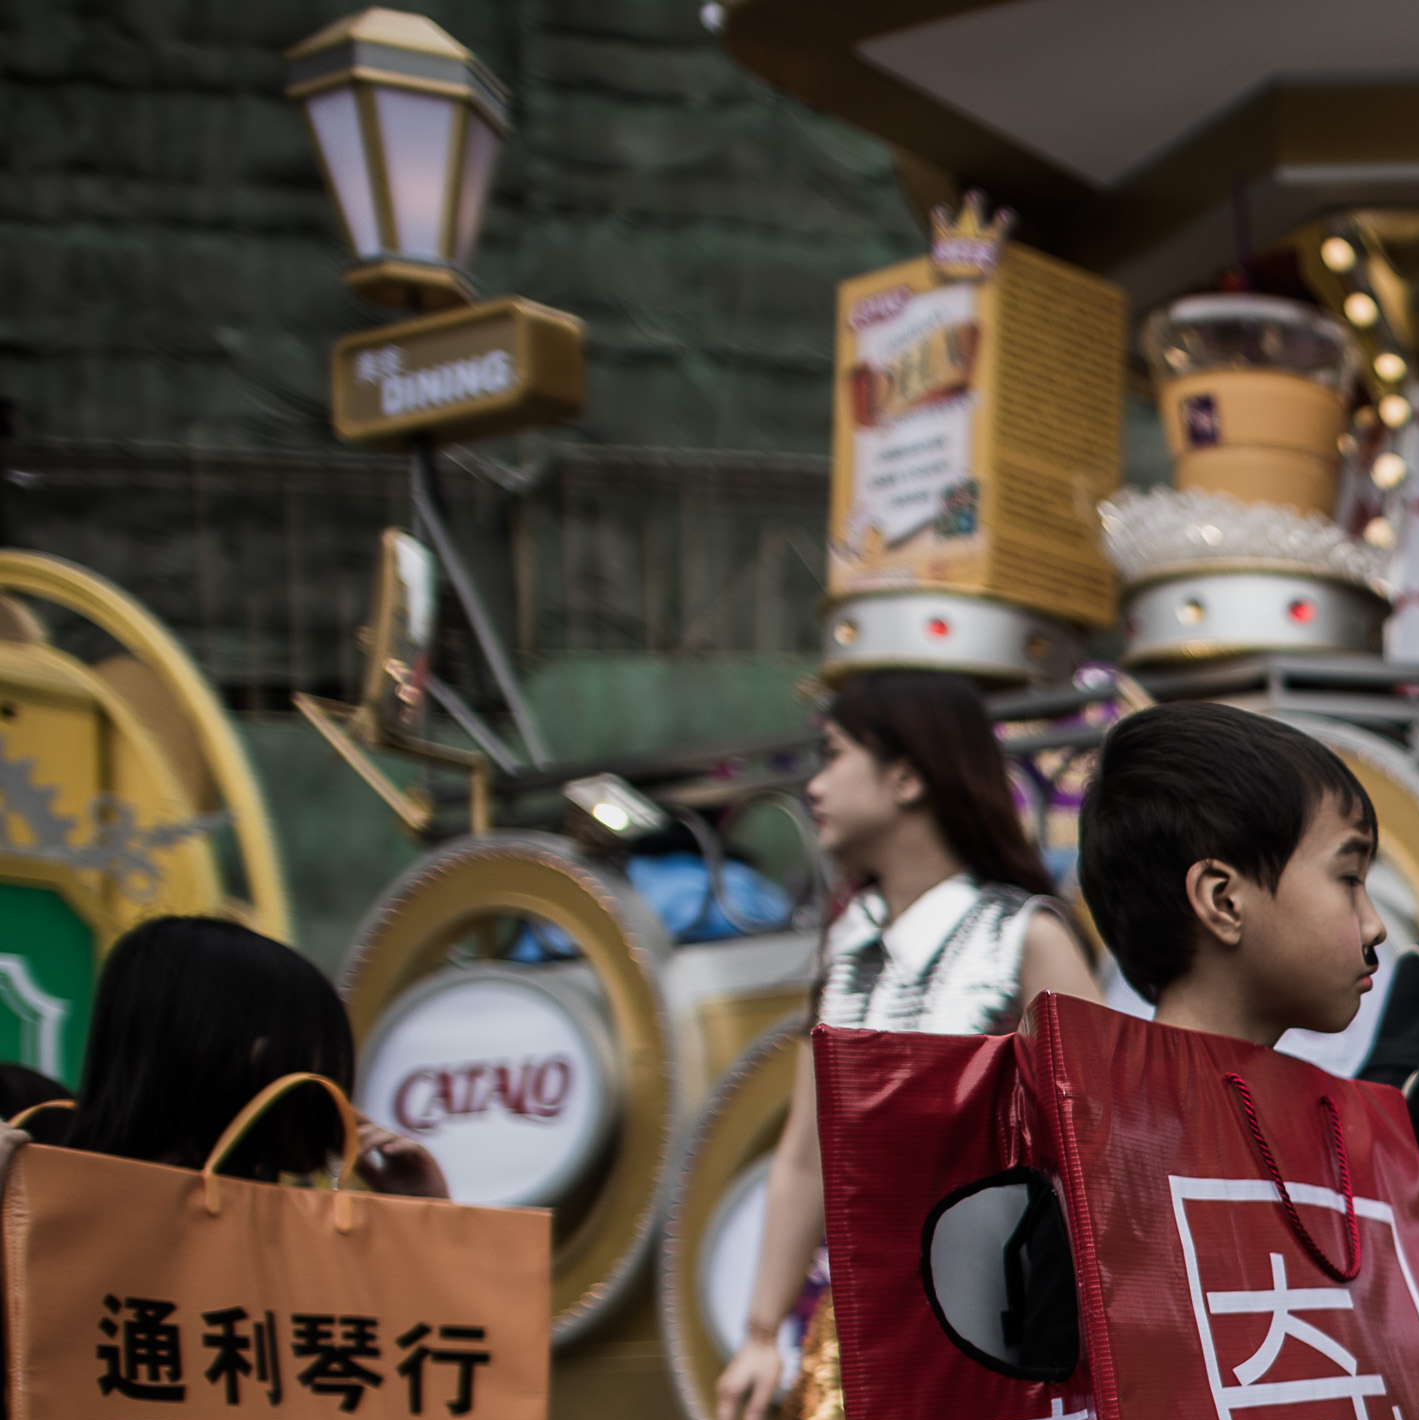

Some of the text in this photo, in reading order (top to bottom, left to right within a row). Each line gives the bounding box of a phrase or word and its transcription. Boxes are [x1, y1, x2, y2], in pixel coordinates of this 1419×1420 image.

[394, 1056, 573, 1133] CATALO
[96, 1294, 490, 1416] 通利琴行
